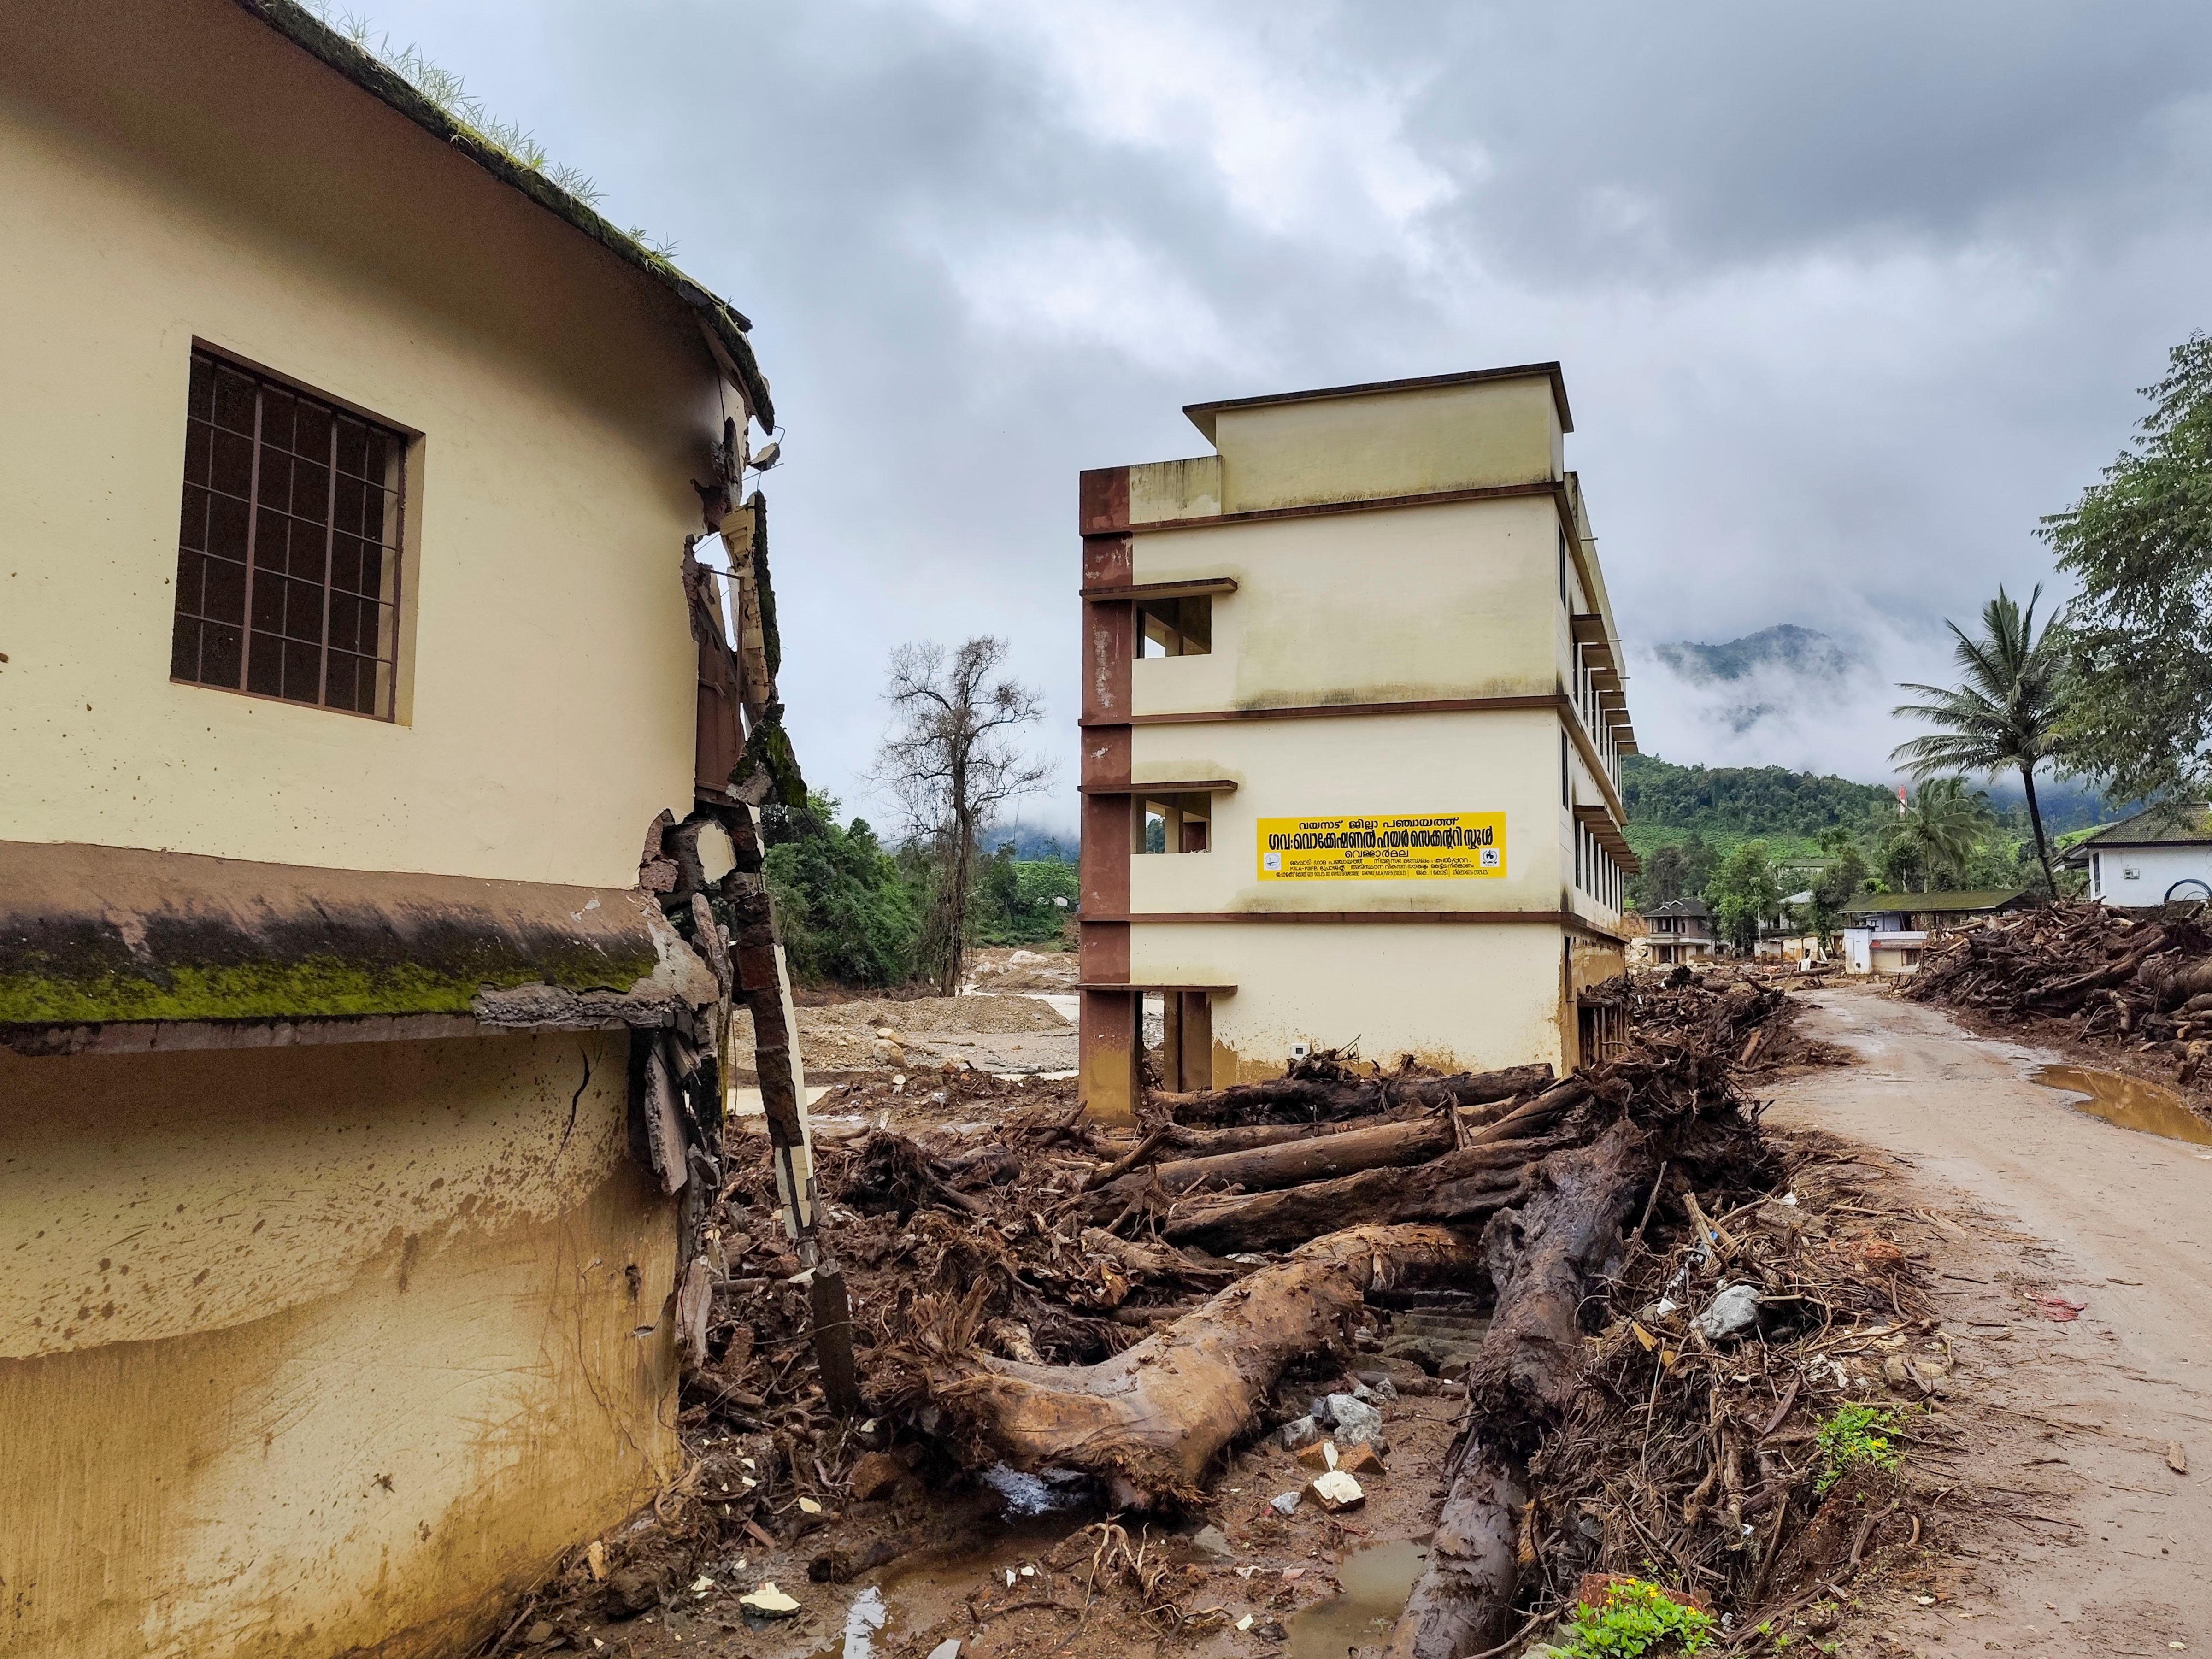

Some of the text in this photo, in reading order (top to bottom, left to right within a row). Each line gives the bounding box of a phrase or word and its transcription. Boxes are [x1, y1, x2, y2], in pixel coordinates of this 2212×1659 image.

[1299, 817, 1459, 830] വയനാട് ജില്ലാ പഞ്ചായത്ത്
[1377, 829, 1409, 848] ഹയർ
[1464, 825, 1493, 849] സ്കൂൾ
[1345, 848, 1409, 858] വെള്ളാർമല
